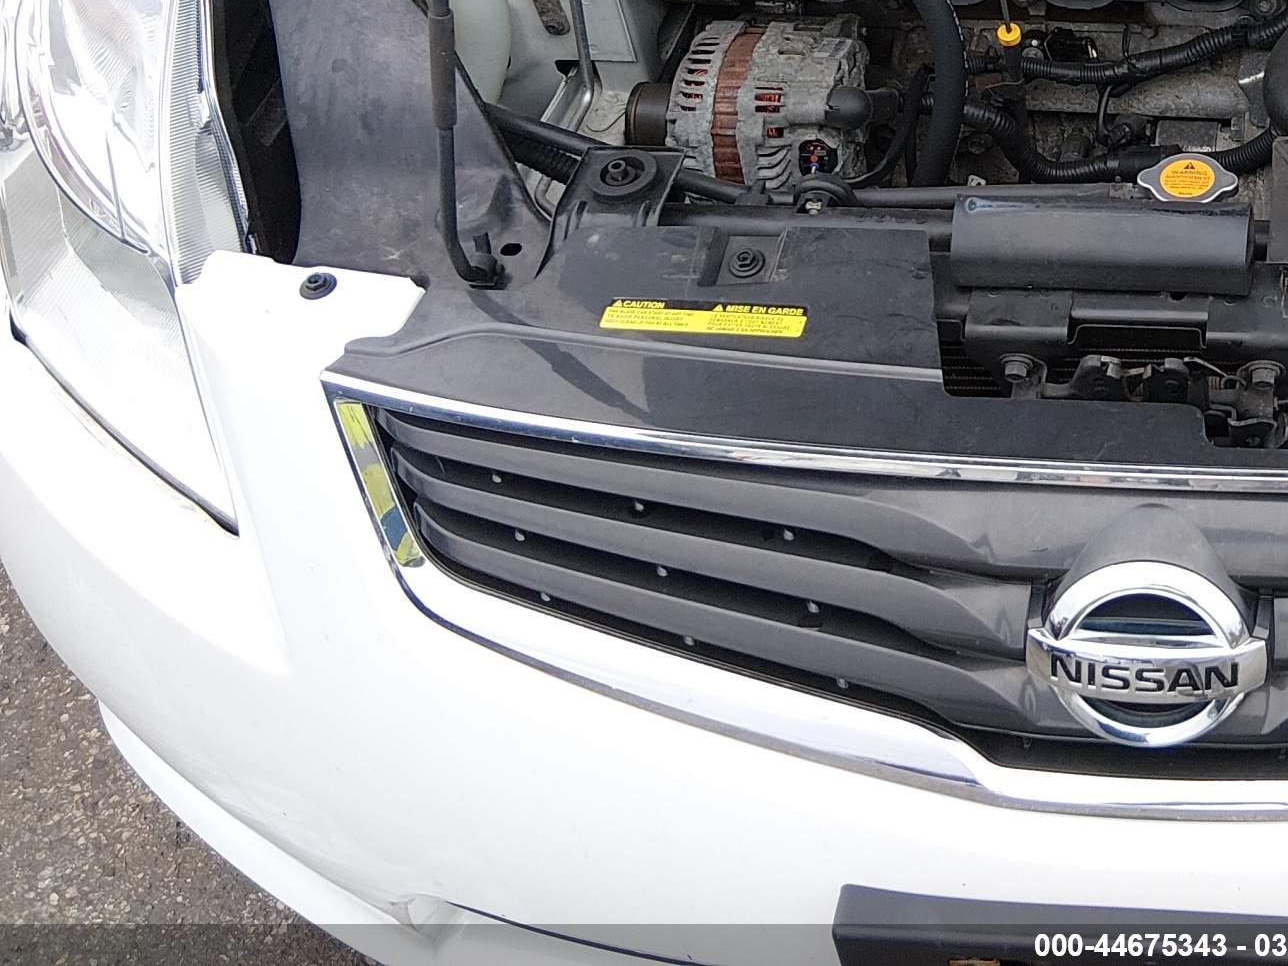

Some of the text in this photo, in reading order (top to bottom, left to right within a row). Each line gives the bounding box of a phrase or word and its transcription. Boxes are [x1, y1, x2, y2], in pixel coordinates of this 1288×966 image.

[623, 300, 665, 309] CAUTION
[726, 305, 804, 316] MISE EN GARDE
[1051, 653, 1238, 693] NISSAN
